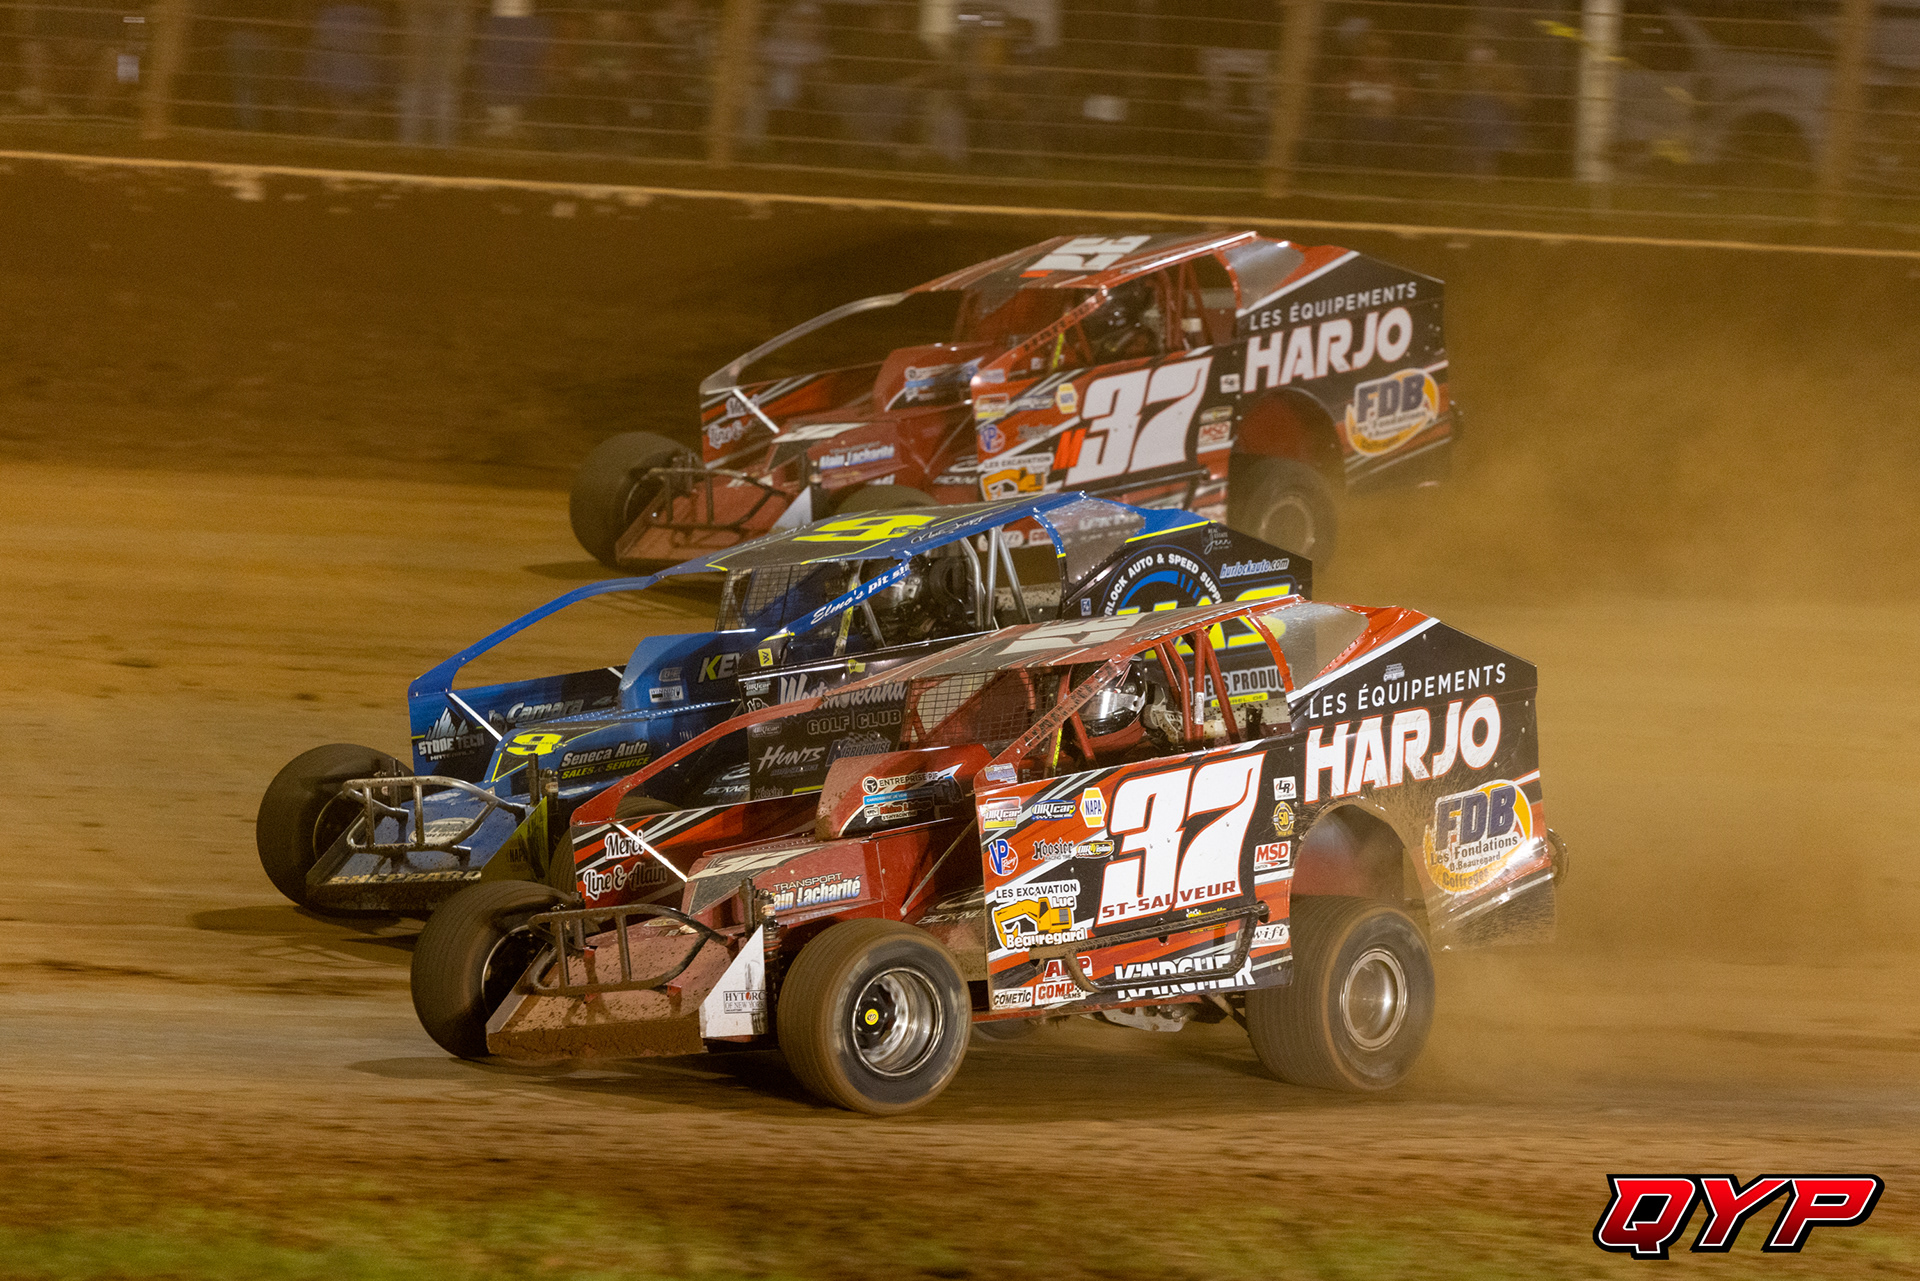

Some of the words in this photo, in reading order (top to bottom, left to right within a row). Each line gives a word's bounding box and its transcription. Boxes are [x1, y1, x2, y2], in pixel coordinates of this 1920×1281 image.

[1250, 309, 1282, 331] LES
[1289, 282, 1417, 323] ÉQUIPEMENTS
[1243, 307, 1413, 393] HARJO
[1356, 373, 1425, 423] FDB
[1064, 357, 1213, 487] 37
[1219, 558, 1290, 579] hurlockauto.com
[1104, 577, 1128, 617] RLOCK
[1127, 554, 1154, 578] AUTO
[1156, 553, 1165, 565] &
[1168, 553, 1199, 574] SPEED
[810, 589, 865, 625] Elmo's
[868, 574, 889, 594] pit
[1310, 693, 1347, 719] LES
[1357, 662, 1506, 711] ÉQUIPEMENTS
[507, 700, 584, 723] Camara
[807, 717, 850, 735] GOLF
[856, 710, 901, 729] CLUB
[417, 737, 456, 756] STONE
[456, 733, 485, 750] TECH
[506, 733, 563, 756] 9
[561, 748, 613, 767] Seneca
[615, 740, 648, 758] Auto
[1304, 695, 1501, 804] HARJO
[561, 766, 593, 780] SALES
[605, 757, 650, 772] SERVICE
[879, 774, 927, 787] ENTREPRISE
[1085, 799, 1102, 815] NAPA
[1435, 785, 1516, 851] FDB
[605, 830, 645, 860] Merci
[1032, 837, 1074, 860] Hoosier
[1097, 752, 1266, 926] 37
[1256, 842, 1289, 863] MSD
[1431, 852, 1450, 866] Les
[1455, 836, 1518, 859] Fondations
[988, 839, 1009, 875] VP
[583, 869, 614, 899] Line
[615, 869, 628, 890] &
[628, 863, 667, 888] Alain
[773, 873, 842, 891] TRANSPORT
[773, 890, 795, 911] ain
[797, 875, 863, 906] Lacharité
[996, 888, 1014, 899] LES
[1016, 883, 1077, 898] EXCAVATION
[1102, 880, 1236, 918] ST-SAUVEUR
[1006, 927, 1088, 949] Beauregard
[725, 992, 765, 1001] HYTORC
[1038, 983, 1075, 1001] COMP
[1063, 992, 1082, 1000] CAMS
